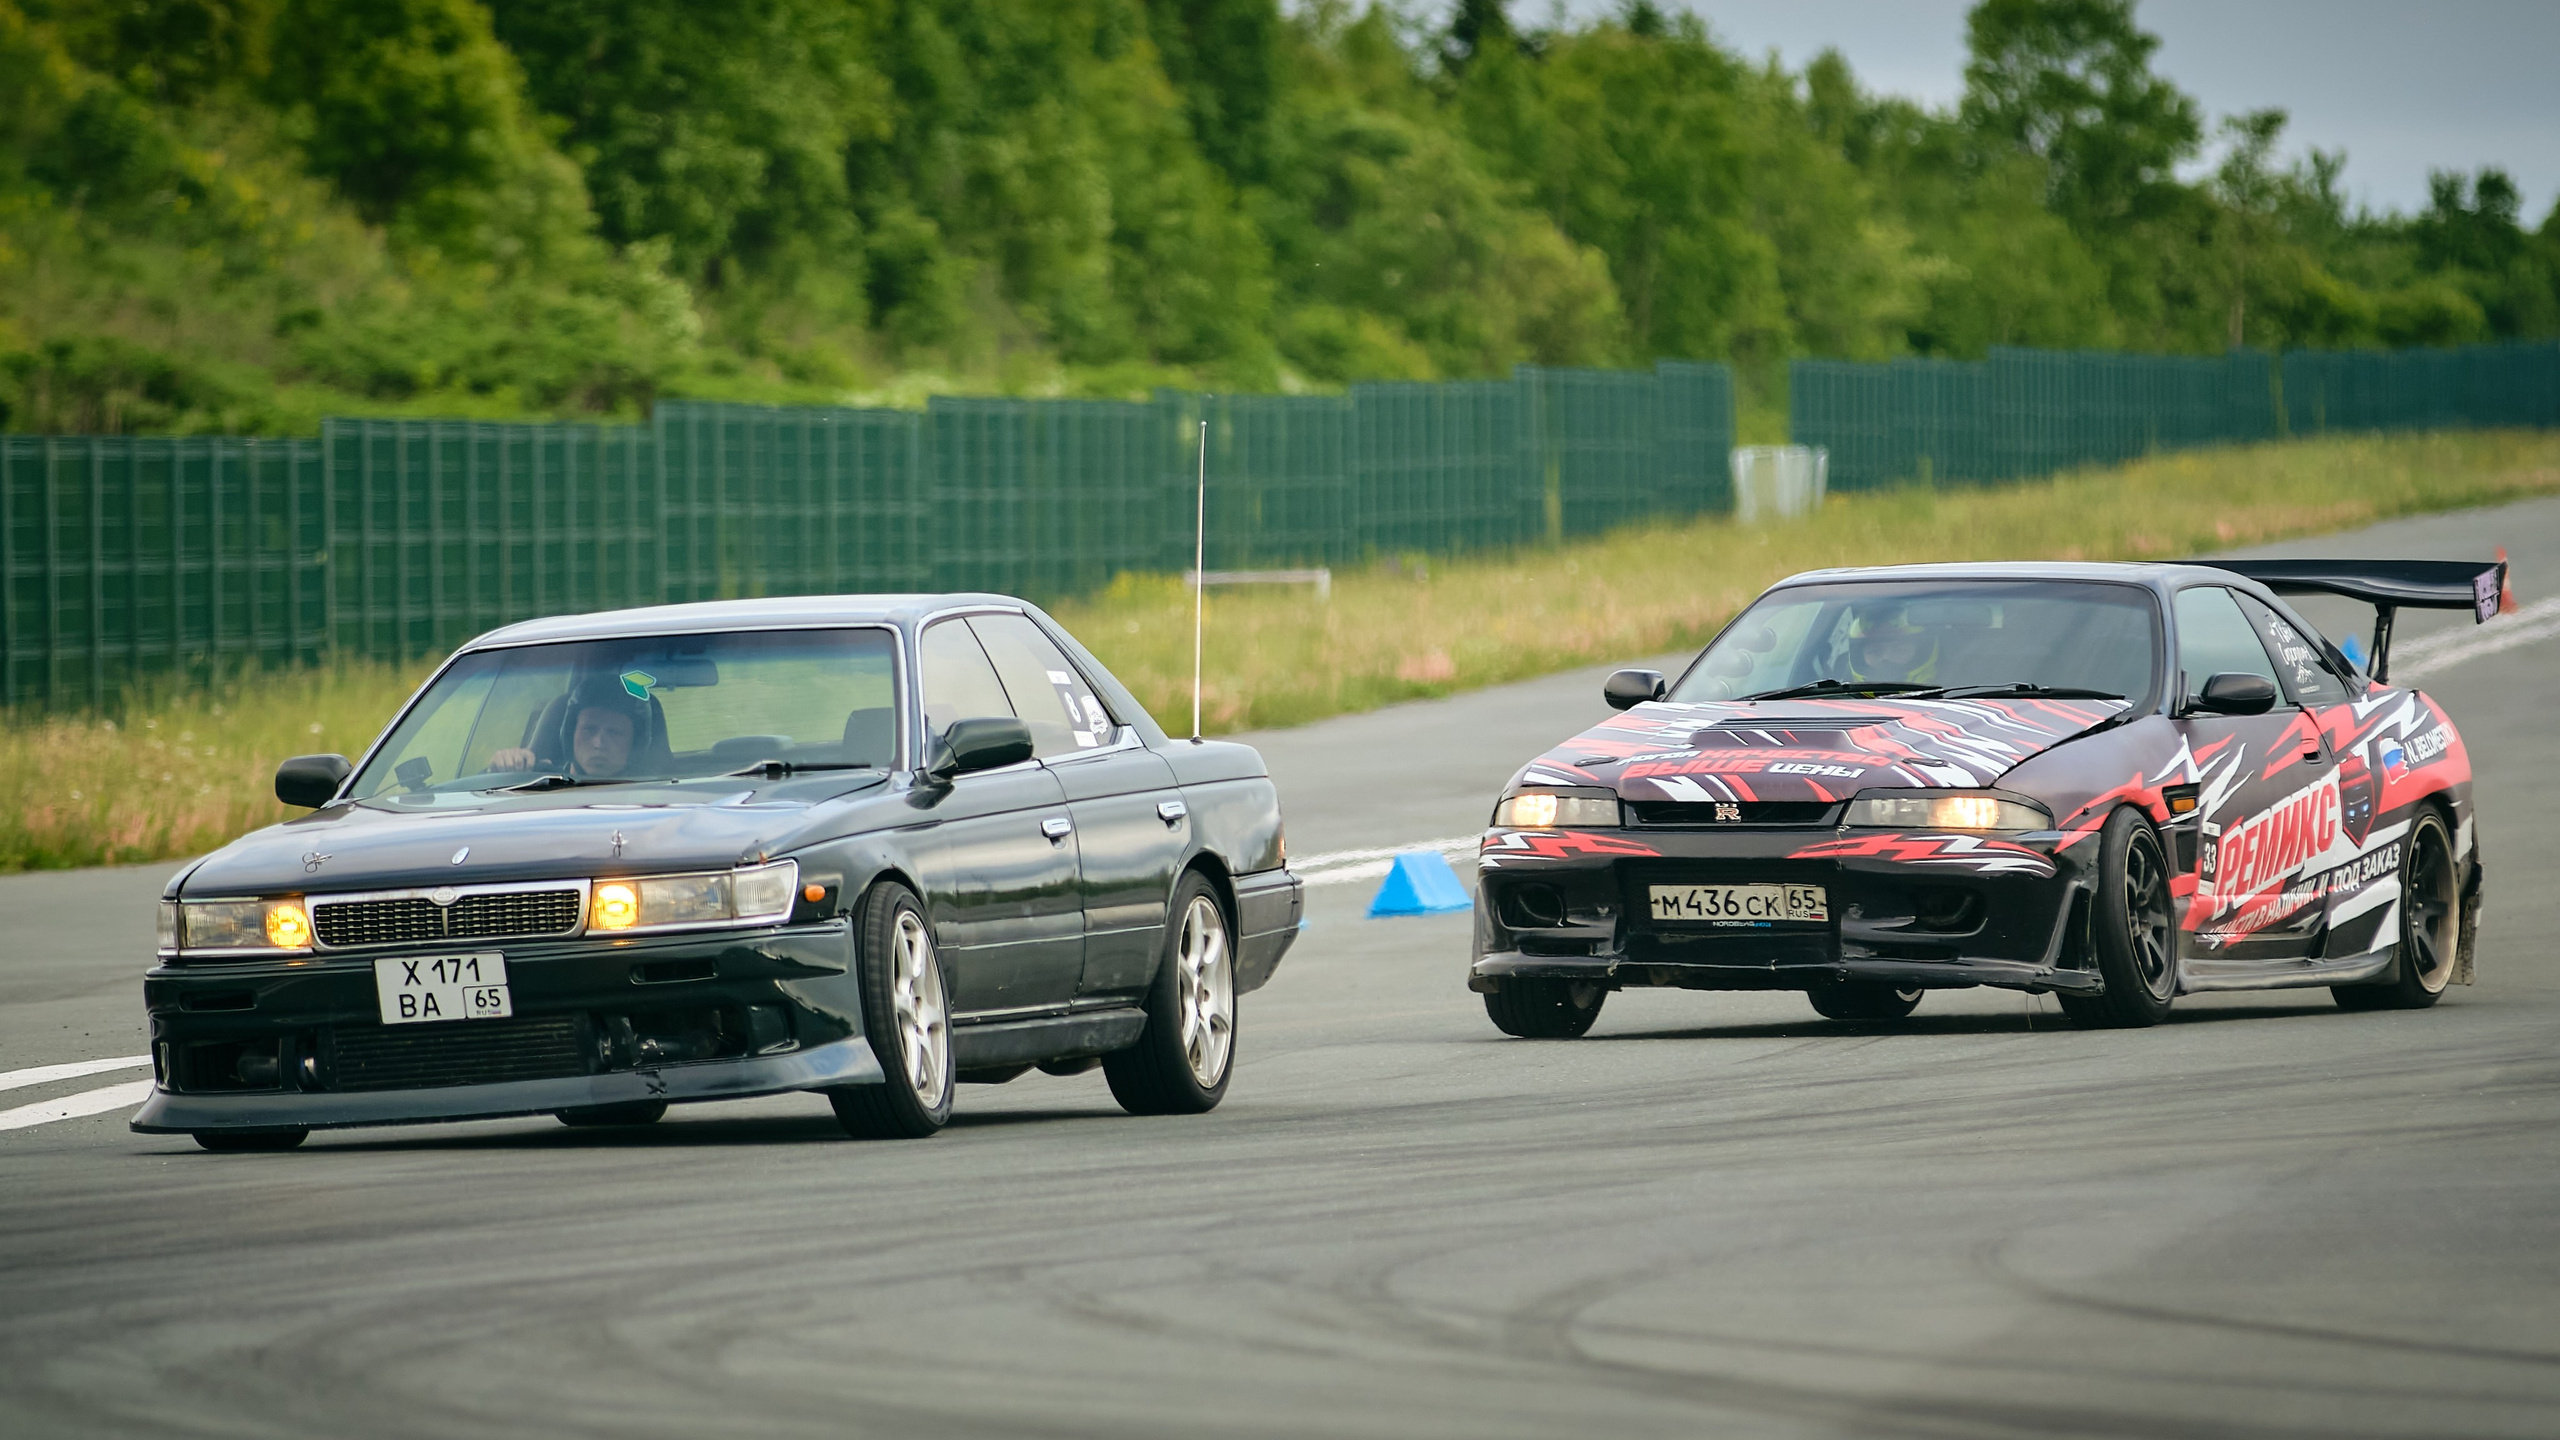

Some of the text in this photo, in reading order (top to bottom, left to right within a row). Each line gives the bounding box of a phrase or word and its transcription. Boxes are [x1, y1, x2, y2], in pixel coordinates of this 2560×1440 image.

[1064, 692, 1082, 723] 8
[1619, 759, 1866, 780] ВЫШЕ ЦЕНЫ
[2203, 842, 2217, 874] 33
[2213, 781, 2338, 917] РЕМИКС
[2333, 861, 2361, 893] ПОД
[2361, 843, 2401, 882] ЗАКАЗ
[1789, 889, 1817, 910] 65
[1788, 909, 1810, 919] RUS
[474, 989, 501, 1008] 65
